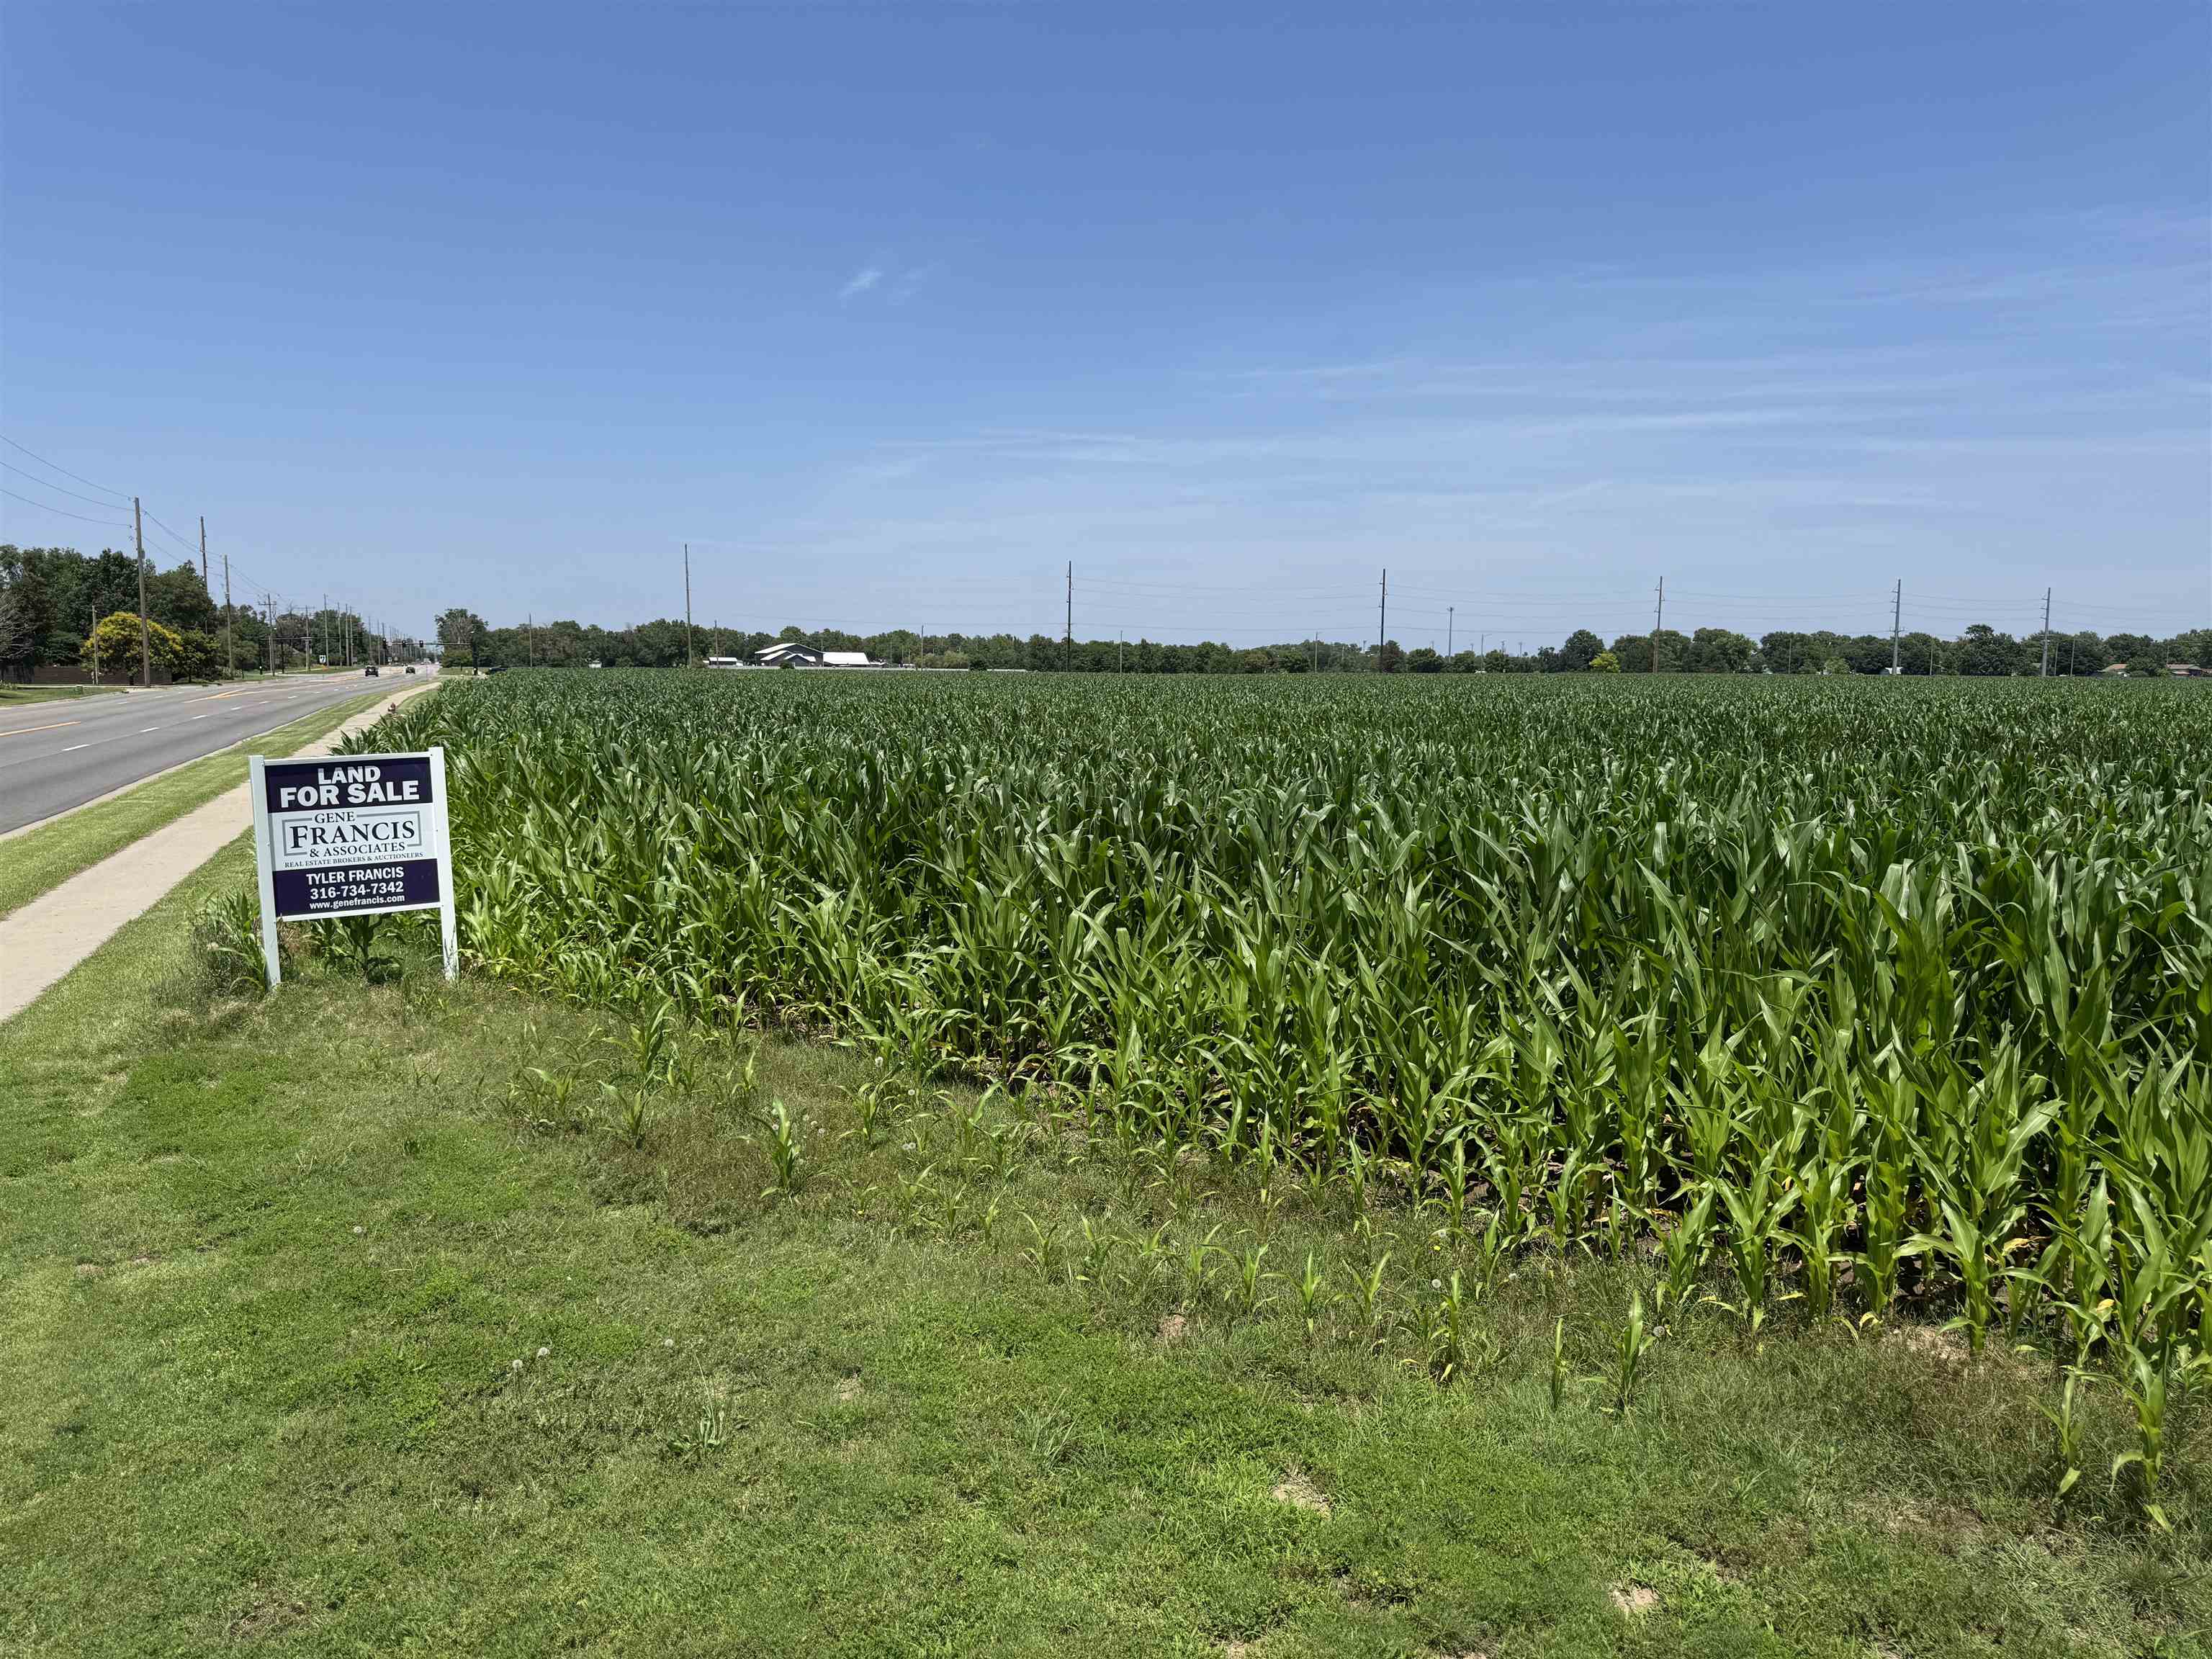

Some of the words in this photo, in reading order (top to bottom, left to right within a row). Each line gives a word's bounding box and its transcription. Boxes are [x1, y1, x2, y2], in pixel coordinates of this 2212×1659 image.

[318, 765, 381, 785] LAND
[280, 786, 340, 808] FOR
[347, 780, 420, 804] SALE
[315, 811, 355, 824] GENE
[289, 820, 415, 848] FRANCIS
[310, 848, 320, 858] &
[323, 842, 405, 857] ASSOCIATES
[374, 852, 423, 861] AUCTIONEERS
[306, 871, 346, 886] TYLER
[349, 867, 404, 882] FRANCIS
[310, 881, 404, 900] 316-734-7342
[309, 894, 405, 909] www.genefrancis.com
